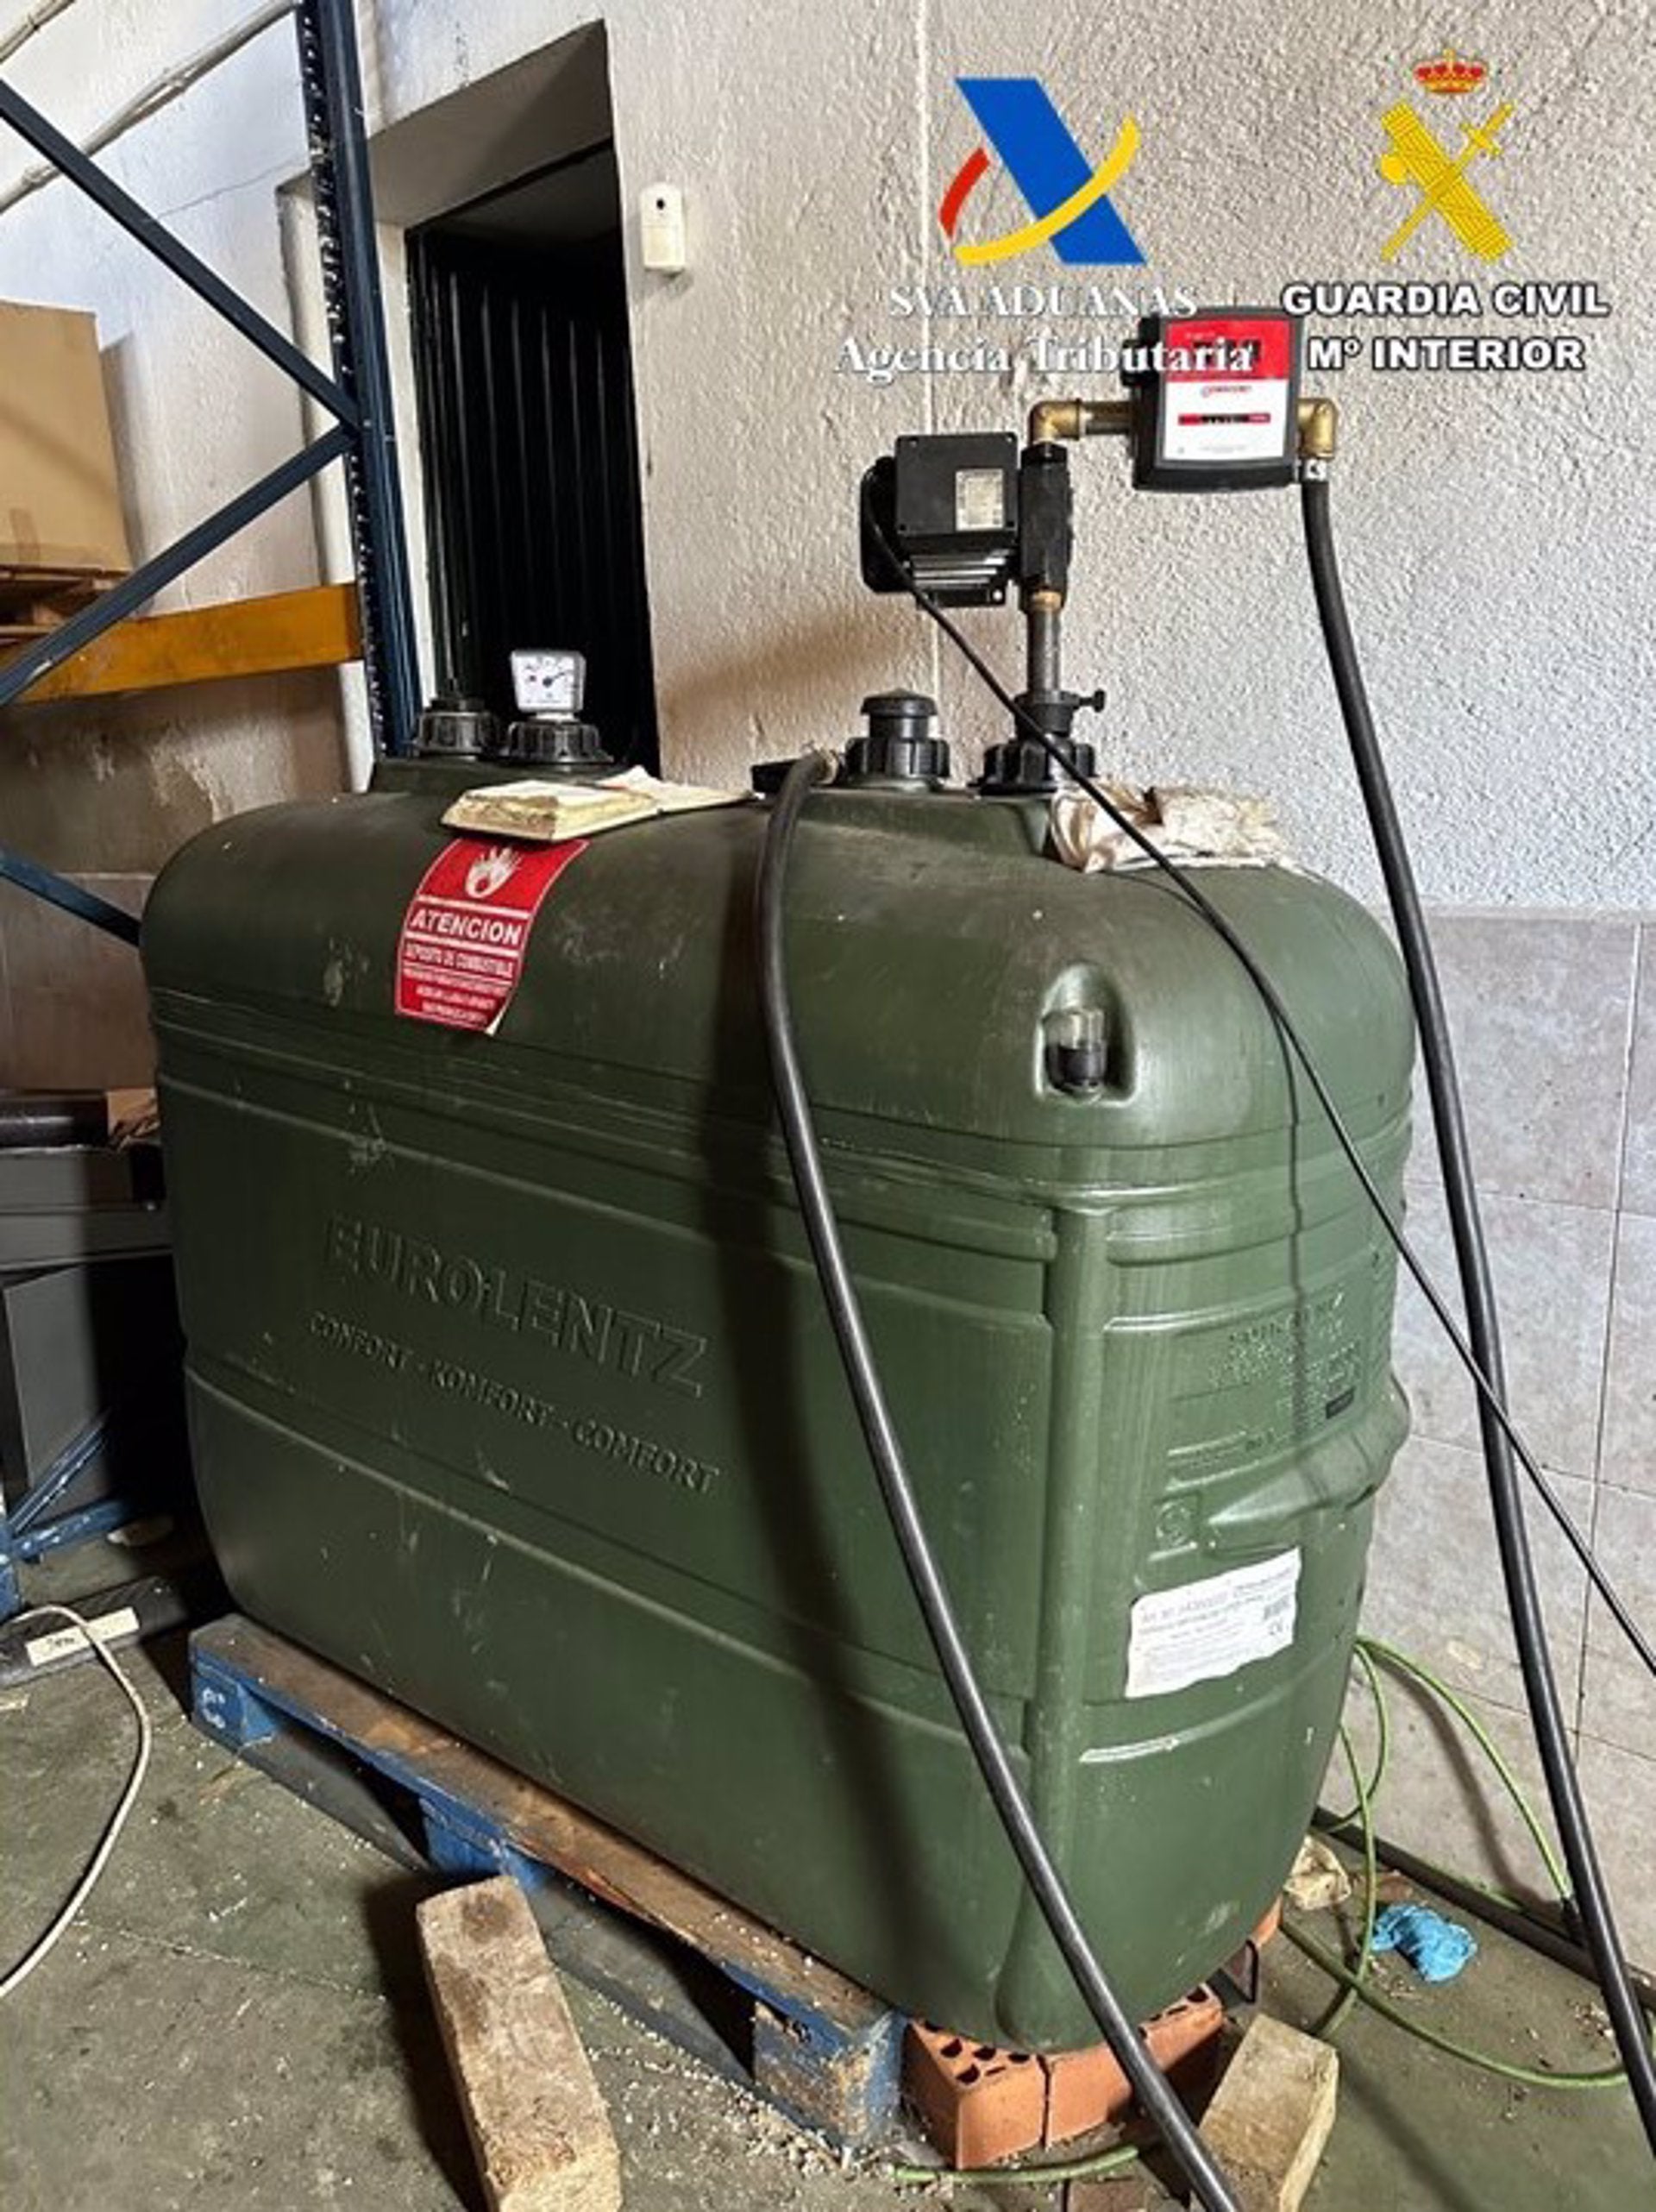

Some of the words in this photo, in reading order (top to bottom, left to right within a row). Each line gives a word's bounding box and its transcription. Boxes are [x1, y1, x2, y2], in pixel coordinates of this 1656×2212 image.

[410, 908, 522, 946] ATENCION
[327, 1216, 707, 1399] EUROLENTZ
[431, 1358, 555, 1428] KOMFORT
[574, 1418, 720, 1493] COMFORT
